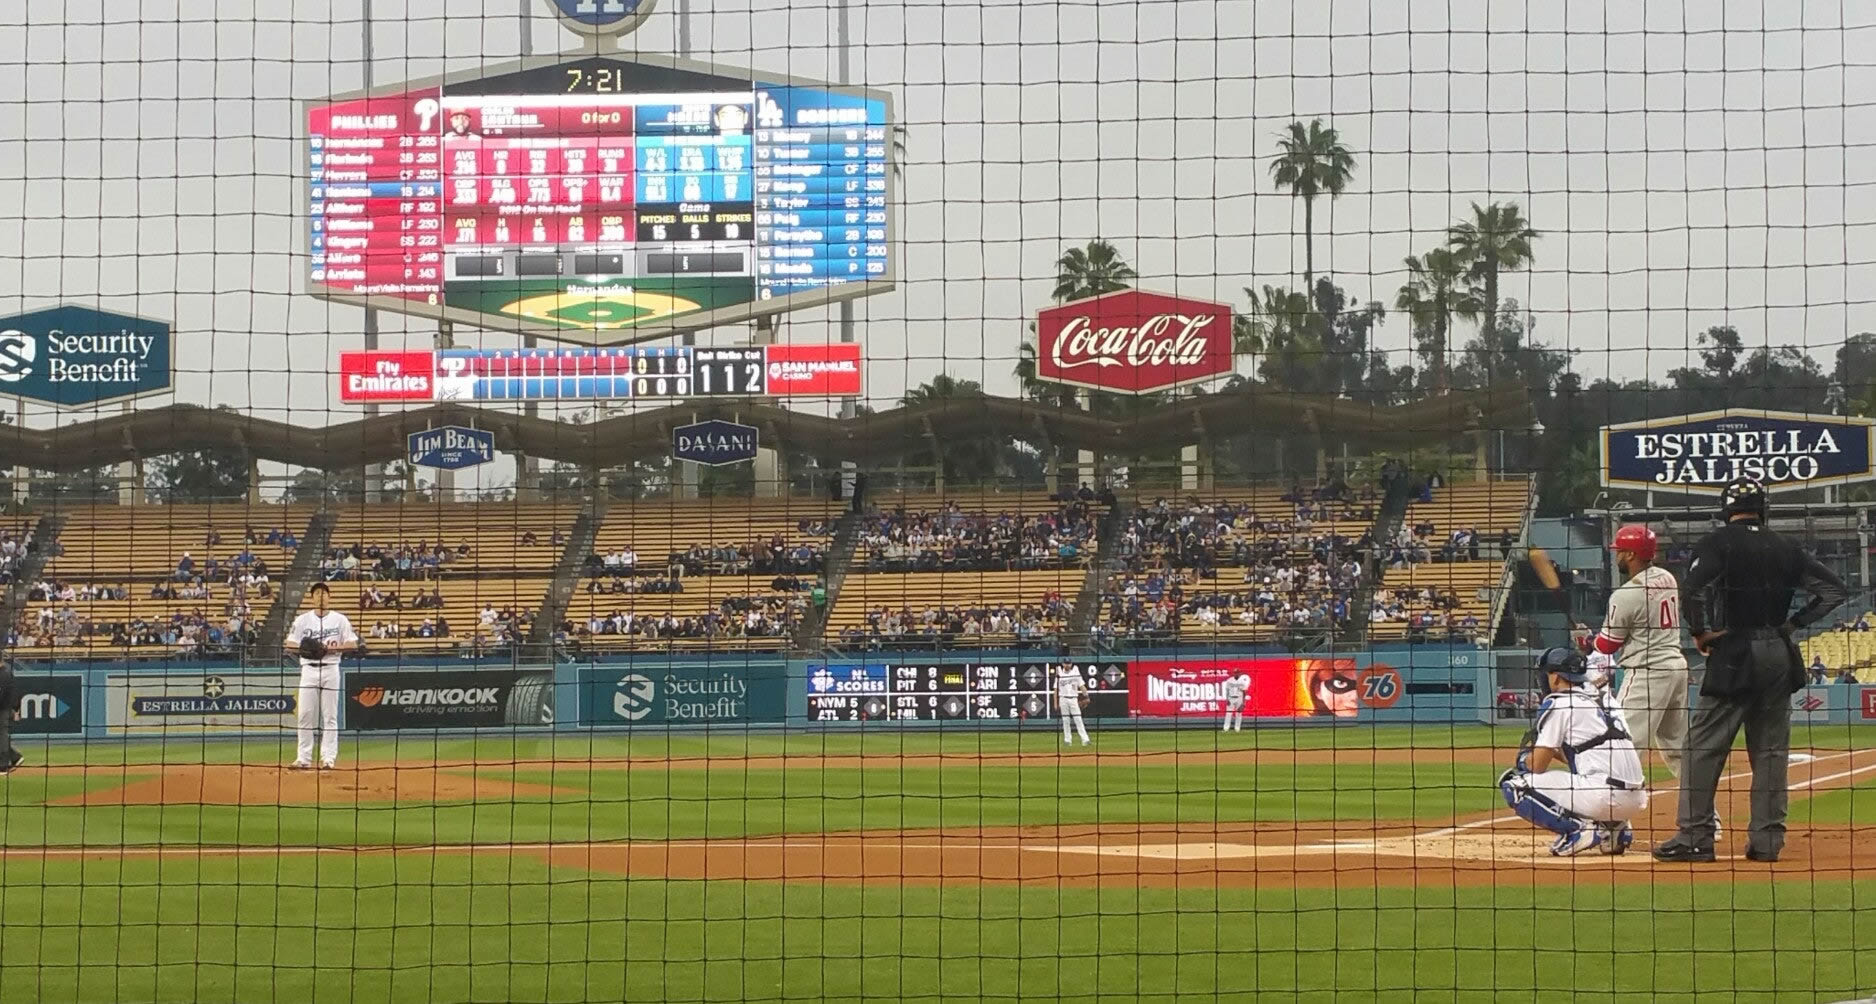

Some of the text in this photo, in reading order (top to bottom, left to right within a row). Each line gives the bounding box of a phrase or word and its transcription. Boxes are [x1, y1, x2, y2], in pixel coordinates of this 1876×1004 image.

[567, 69, 621, 92] 7:21
[331, 115, 398, 129] PHILLIES
[581, 112, 621, 123] 0 for 0
[679, 203, 710, 212] Game
[455, 218, 476, 227] AVG
[497, 218, 505, 226] H
[535, 217, 543, 226] K
[640, 214, 752, 224] PITCHES BALLS STRIKES
[653, 225, 666, 240] 15
[690, 224, 700, 239] 5
[48, 329, 154, 359] Security
[1052, 314, 1215, 368] Coca-Cola
[678, 348, 684, 356] E
[716, 351, 742, 360] Strike
[744, 350, 760, 360] Out
[49, 357, 140, 382] Benefit
[376, 361, 400, 376] Fly
[638, 357, 686, 374] 0 1 0
[782, 361, 857, 372] SAN MANUEL
[350, 375, 428, 392] Emirates
[701, 363, 760, 392] 1 1 2
[638, 378, 686, 394] 0 0 0
[413, 429, 491, 463] JIM BEAM
[680, 432, 751, 452] DASANI
[1634, 429, 1840, 459] ESTRELLA
[1655, 456, 1819, 484] JALISCO
[852, 670, 869, 680] NL
[897, 667, 937, 679] CHI 8
[977, 666, 1016, 678] CIN 1
[1088, 665, 1097, 676] 0
[664, 673, 746, 698] Security
[836, 681, 884, 692] SCORES
[897, 679, 937, 691] PIT 6
[976, 679, 1017, 690] ARI 2
[1088, 678, 1097, 688] 0
[1147, 674, 1228, 701] INCREDIBL
[1362, 673, 1397, 700] 76
[142, 699, 287, 712] ESTRELLA JALISCO
[818, 697, 858, 708] NYM 5
[897, 696, 937, 707] STL 6
[977, 696, 1016, 706] SF 1
[1181, 701, 1207, 711] JUNE
[404, 705, 498, 715] driving emotion
[665, 697, 738, 719] Benefit
[977, 707, 1000, 718] COL
[818, 710, 858, 720] ATL 2
[897, 709, 936, 720] MIL 1
